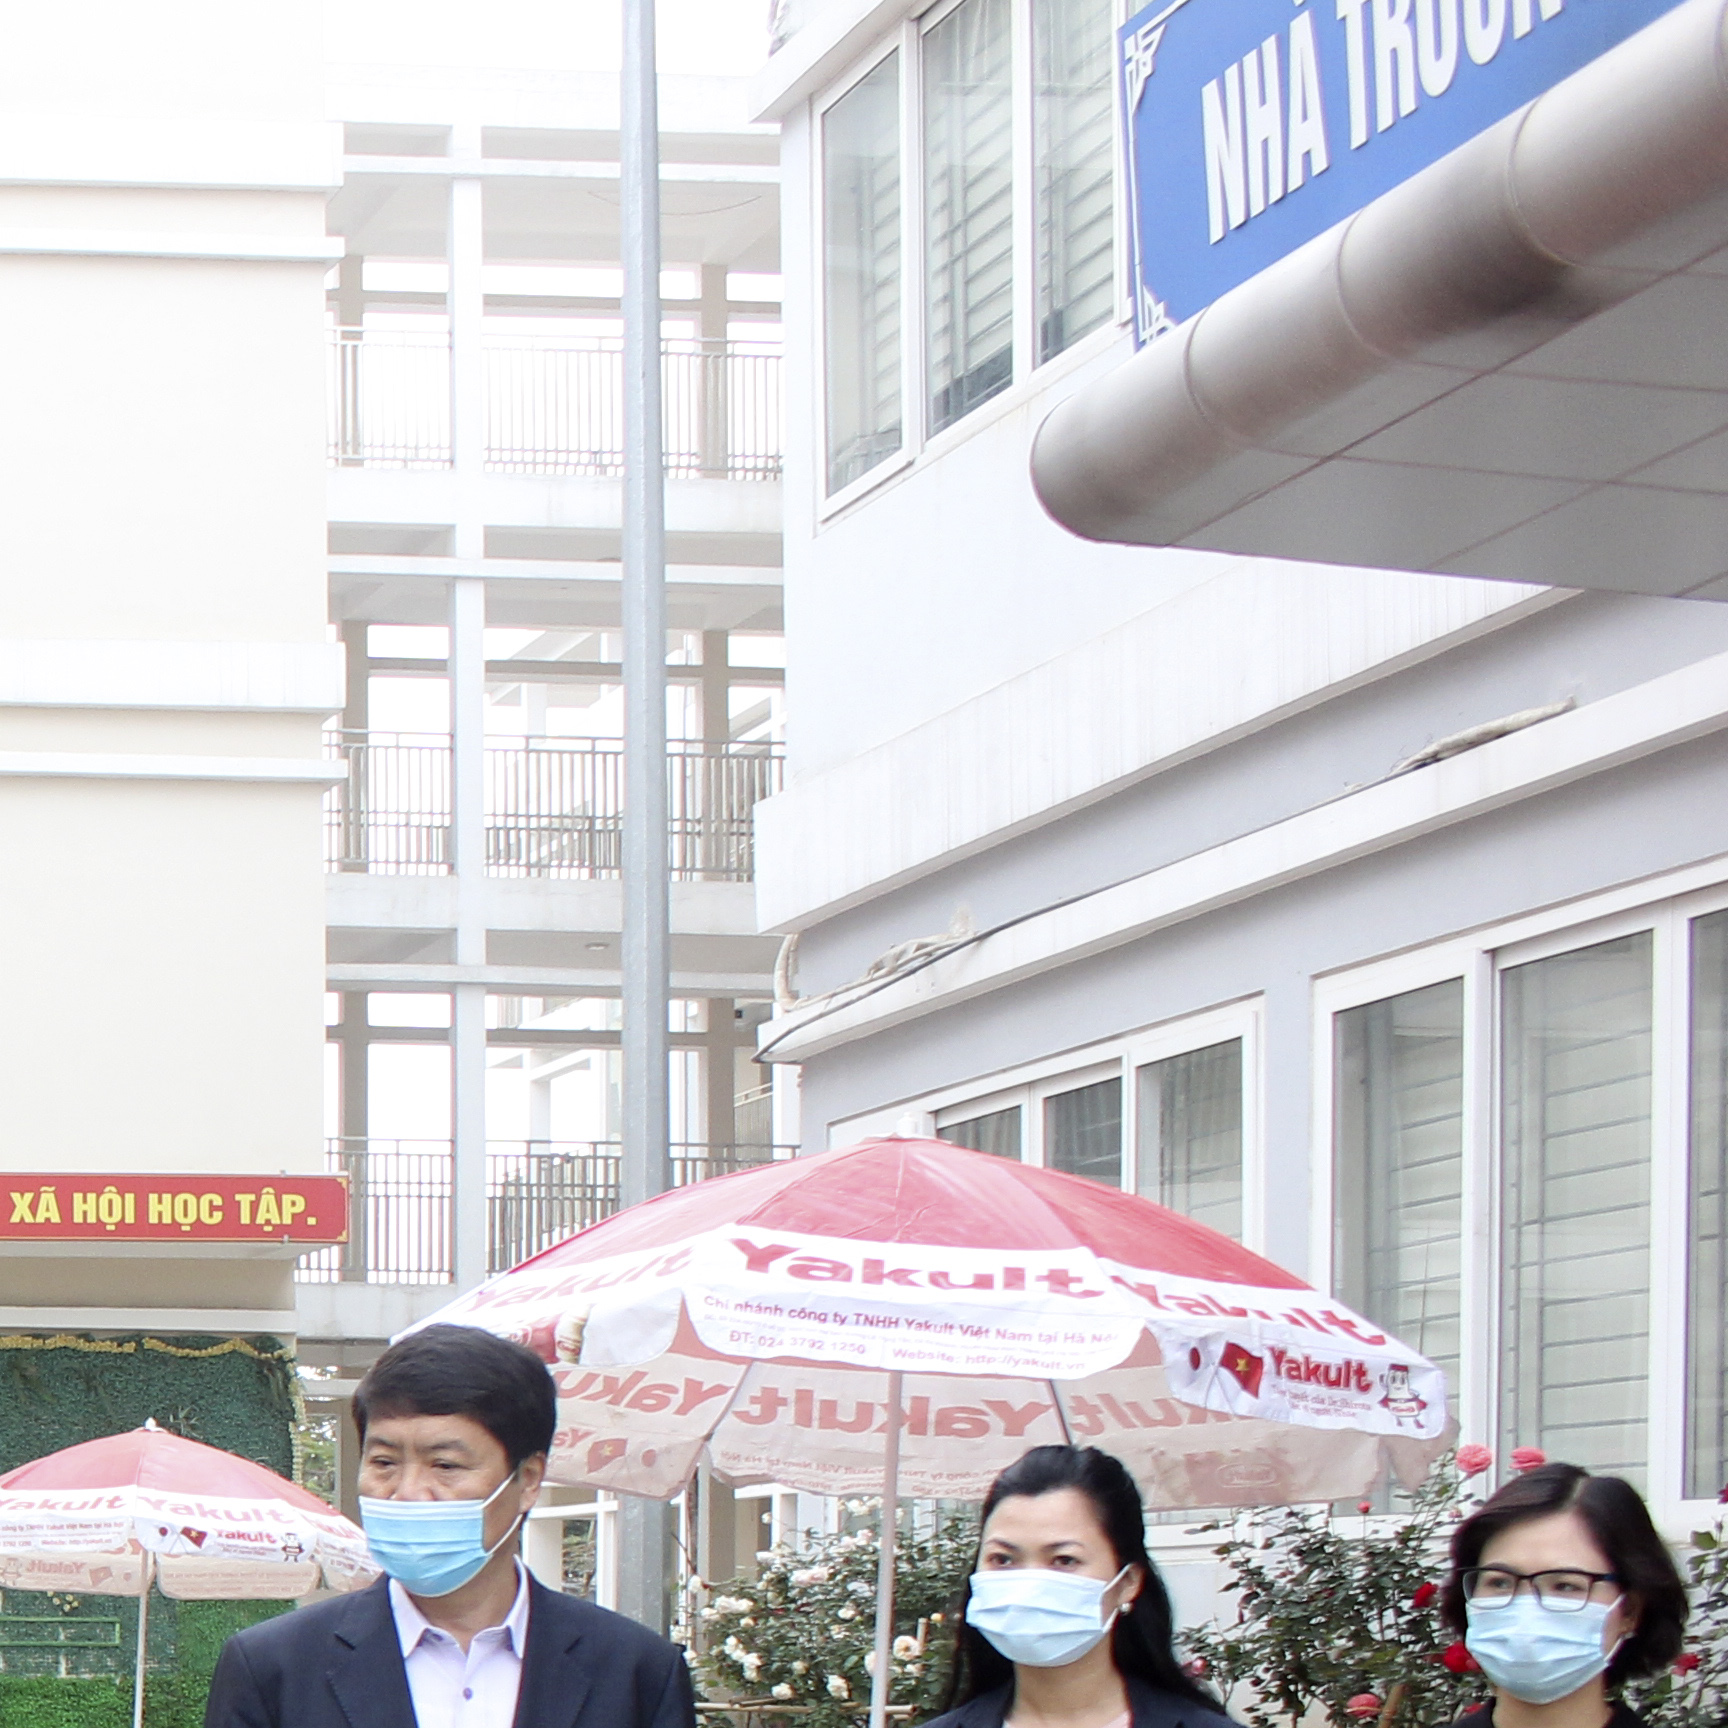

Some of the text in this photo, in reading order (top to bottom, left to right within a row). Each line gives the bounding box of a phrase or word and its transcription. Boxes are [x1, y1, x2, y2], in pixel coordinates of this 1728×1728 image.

[9, 1186, 61, 1223] XÃ
[73, 1186, 135, 1231] HỘI
[148, 1192, 223, 1231] HỌC
[234, 1187, 317, 1232] TẬP.
[729, 1237, 1106, 1299] Yakult
[1266, 1345, 1373, 1394] Yakult
[137, 1496, 294, 1524] Yakult
[214, 1528, 277, 1544] Yakult
